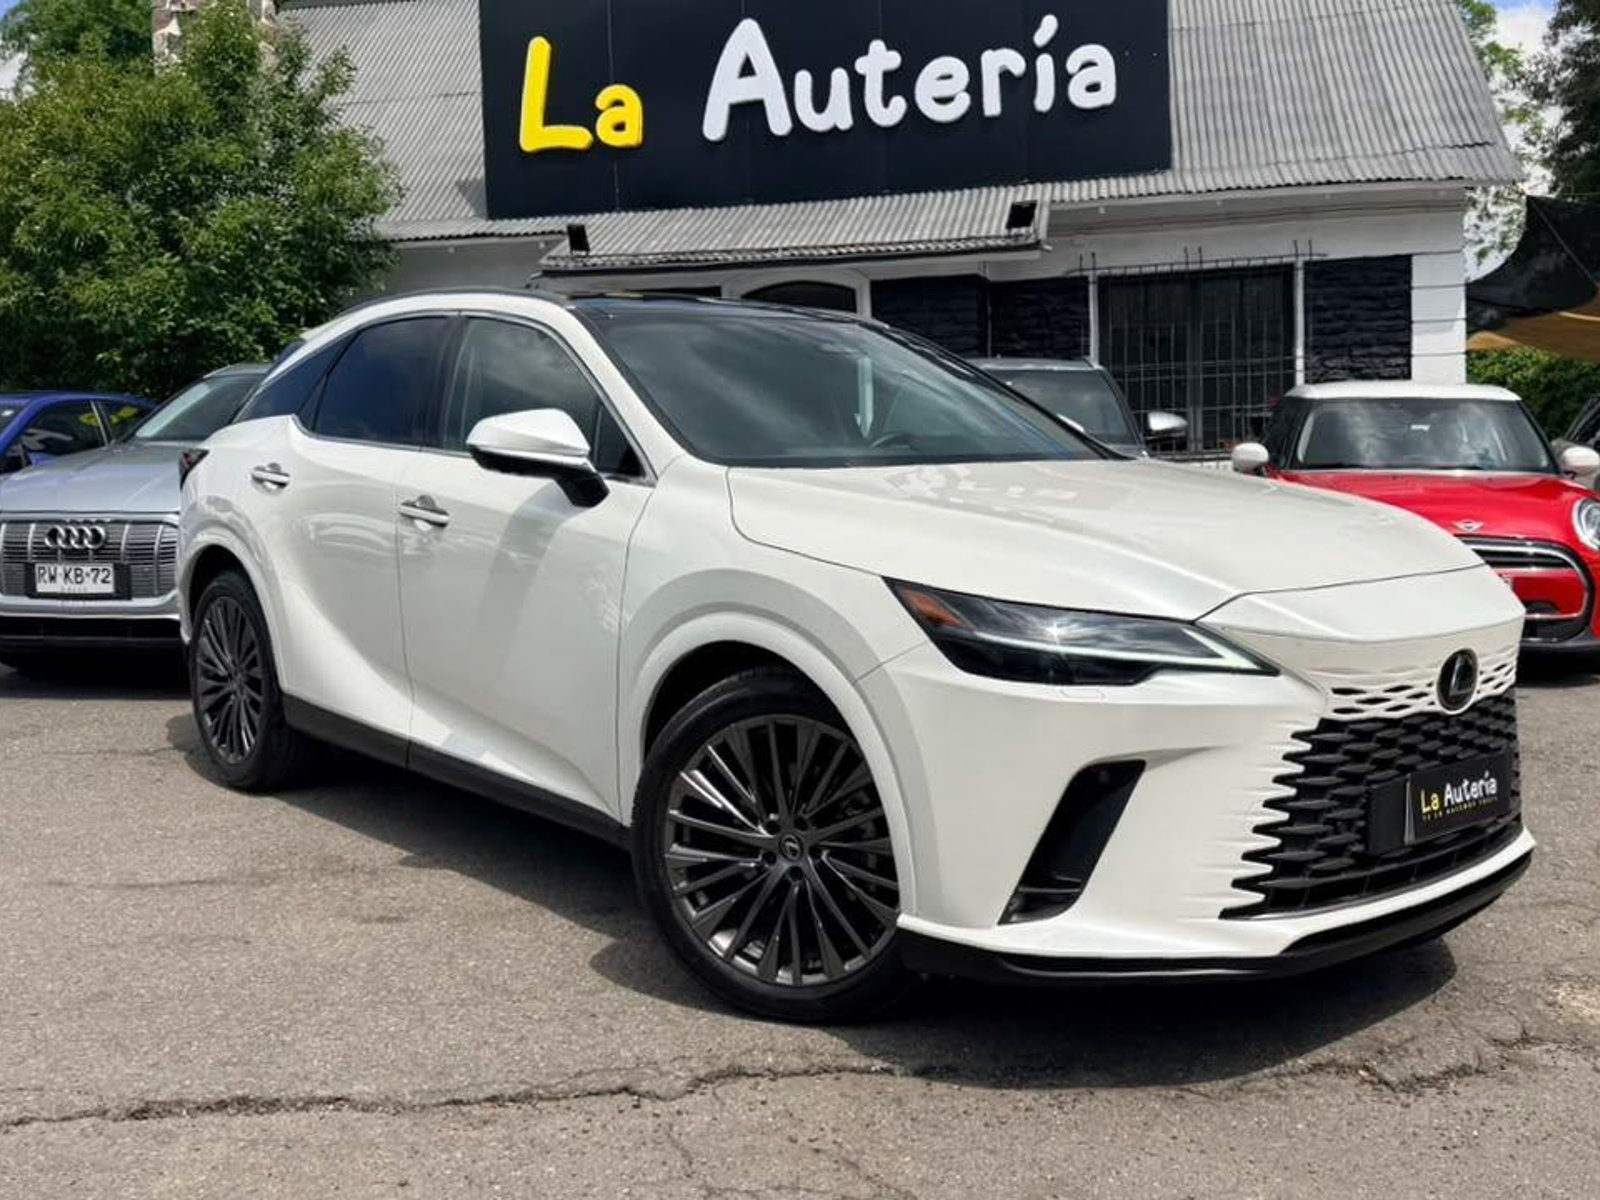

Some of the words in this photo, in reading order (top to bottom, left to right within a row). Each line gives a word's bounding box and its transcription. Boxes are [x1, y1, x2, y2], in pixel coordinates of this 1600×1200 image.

[519, 36, 644, 153] La
[702, 14, 1117, 142] Autería
[1421, 789, 1440, 813] La
[1444, 770, 1497, 807] Autería
